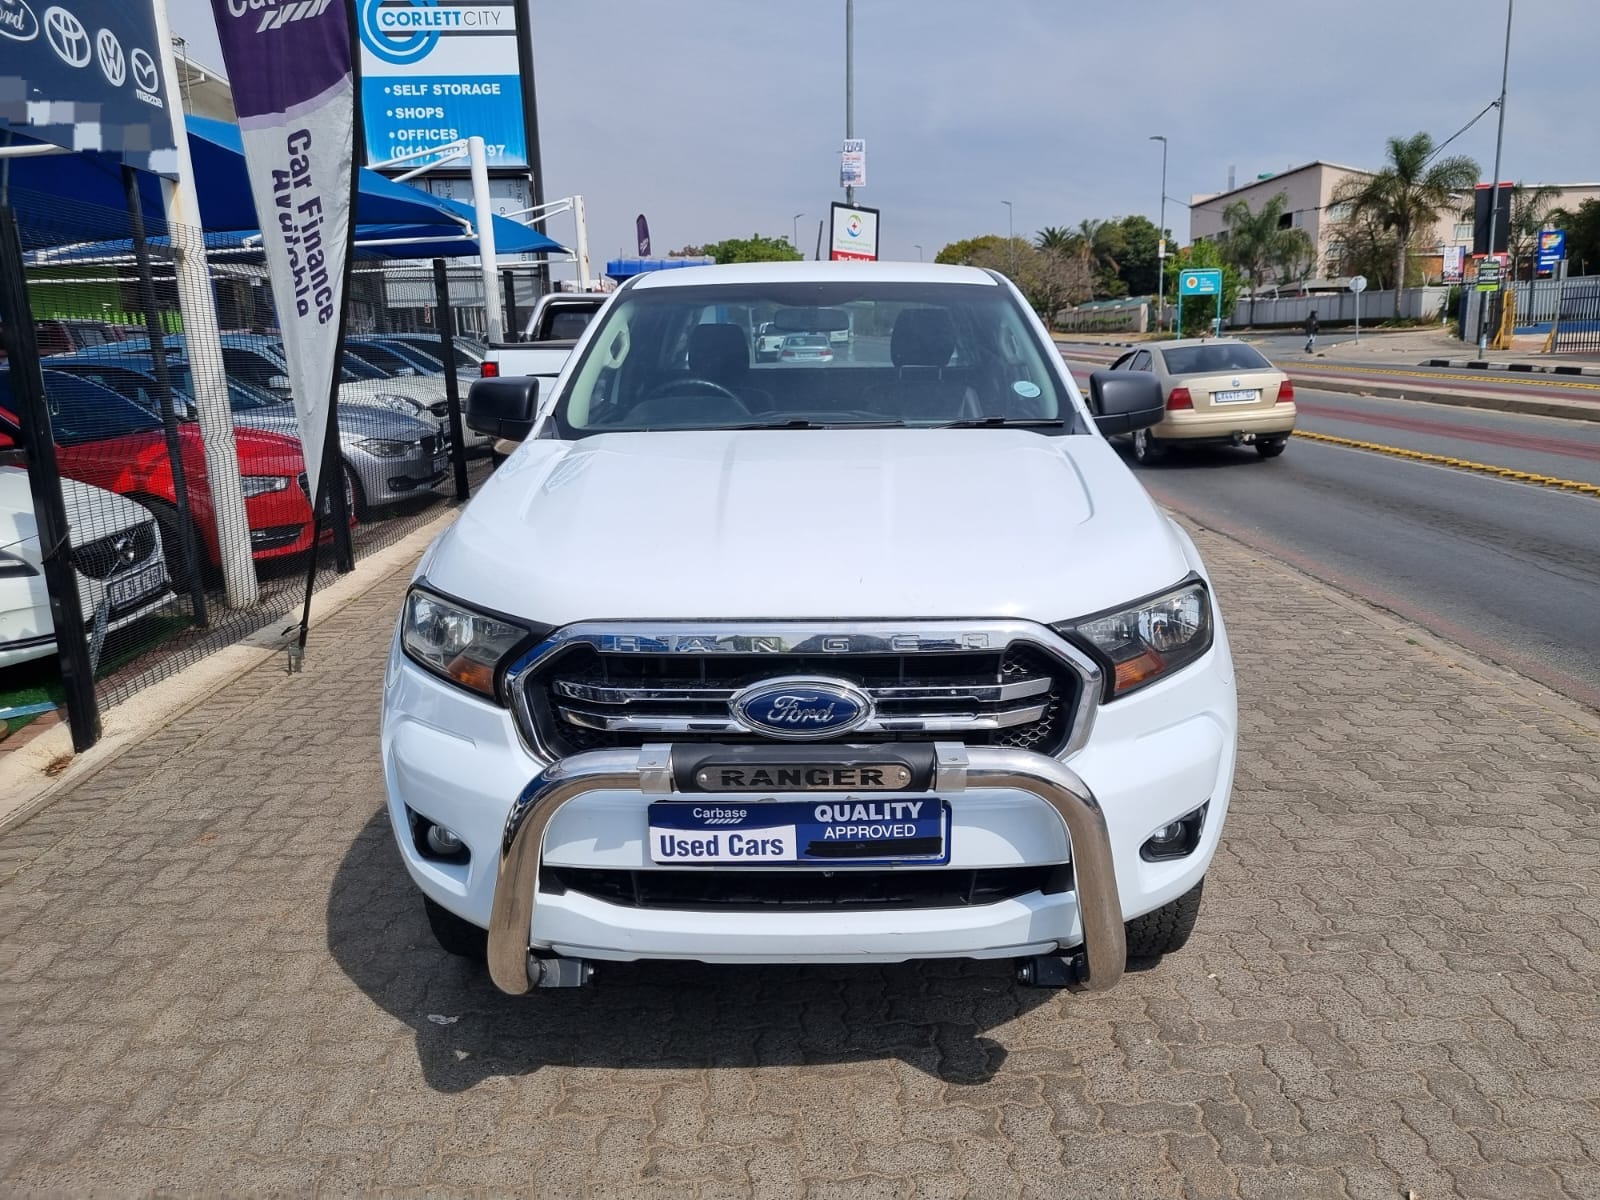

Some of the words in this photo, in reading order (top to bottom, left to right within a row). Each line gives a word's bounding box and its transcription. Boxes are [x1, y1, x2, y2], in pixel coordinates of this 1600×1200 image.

[381, 11, 461, 26] CORLETT
[463, 11, 501, 25] CITY
[393, 84, 428, 96] SELF
[433, 83, 501, 95] STORAGE
[395, 107, 444, 119] SHOPS
[397, 129, 458, 141] OFFICES
[287, 128, 313, 189] Car
[298, 196, 334, 325] Finance
[767, 695, 835, 723] Ford
[721, 768, 885, 787] RANGER
[692, 807, 748, 819] Carbase
[814, 801, 924, 823] QUALITY
[824, 824, 916, 840] APPROVED
[660, 834, 720, 857] Used
[728, 833, 785, 857] Cars
